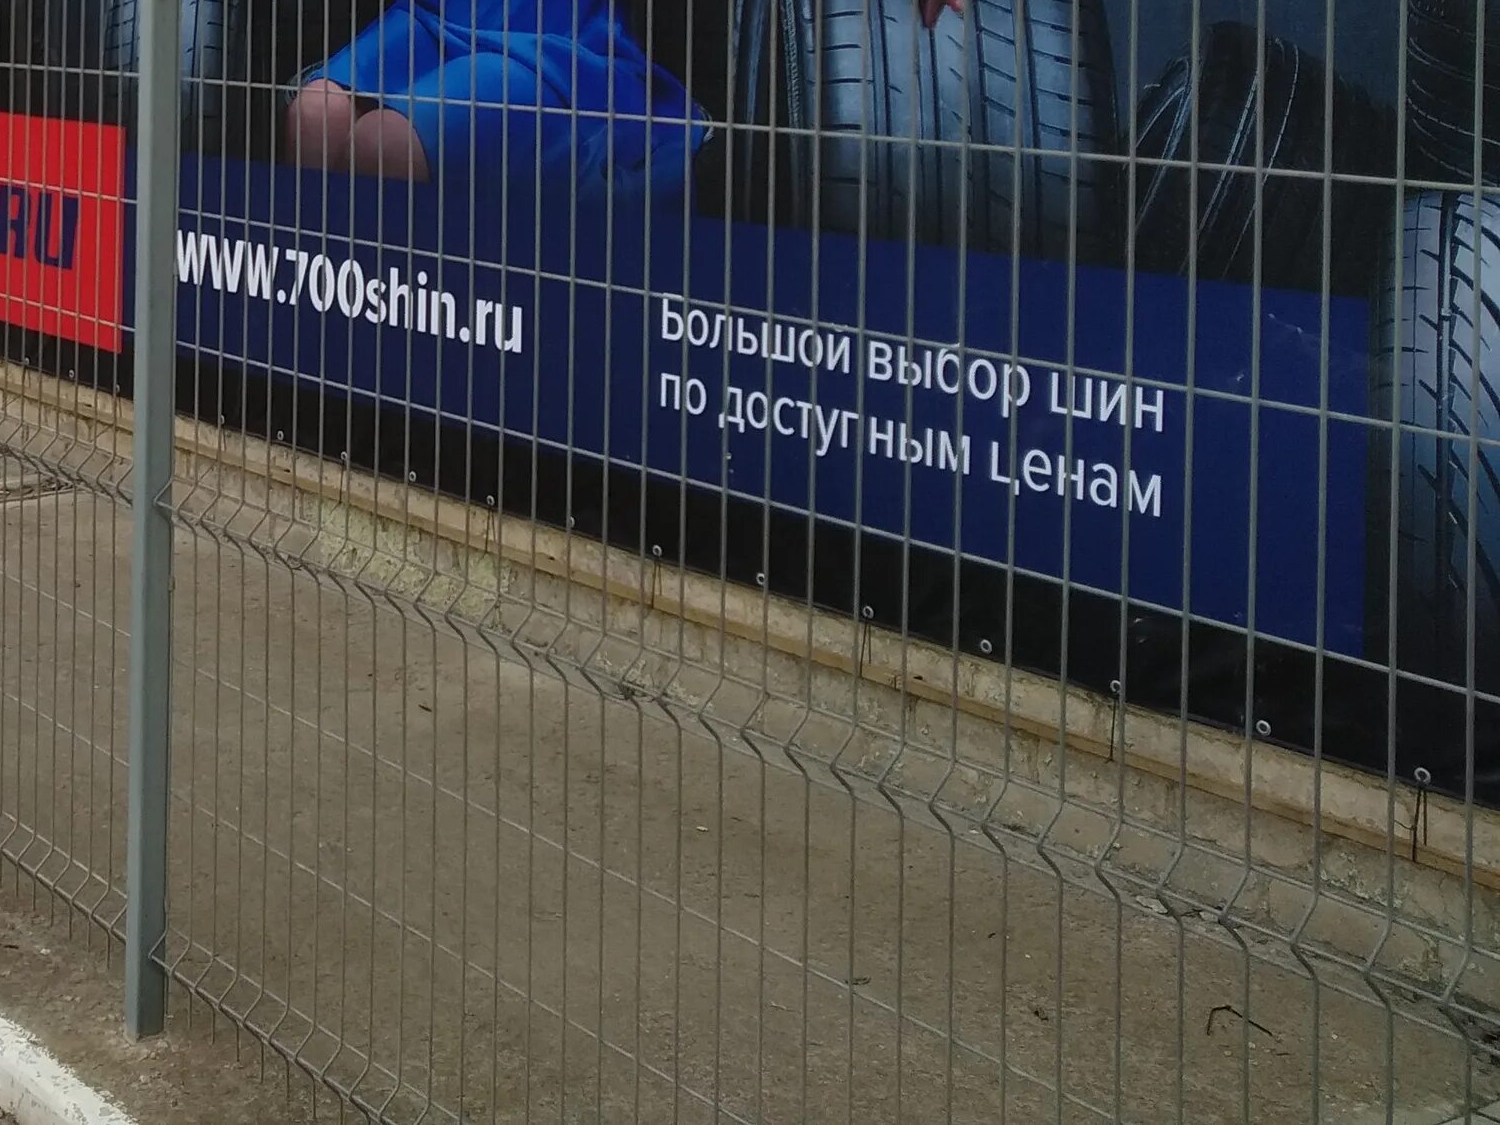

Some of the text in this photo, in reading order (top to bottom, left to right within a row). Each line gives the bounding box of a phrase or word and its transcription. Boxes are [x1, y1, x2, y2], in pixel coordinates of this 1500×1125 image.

[661, 292, 1165, 433] Большой выбор шин
[660, 372, 707, 416] по
[990, 440, 1162, 518] ценам
